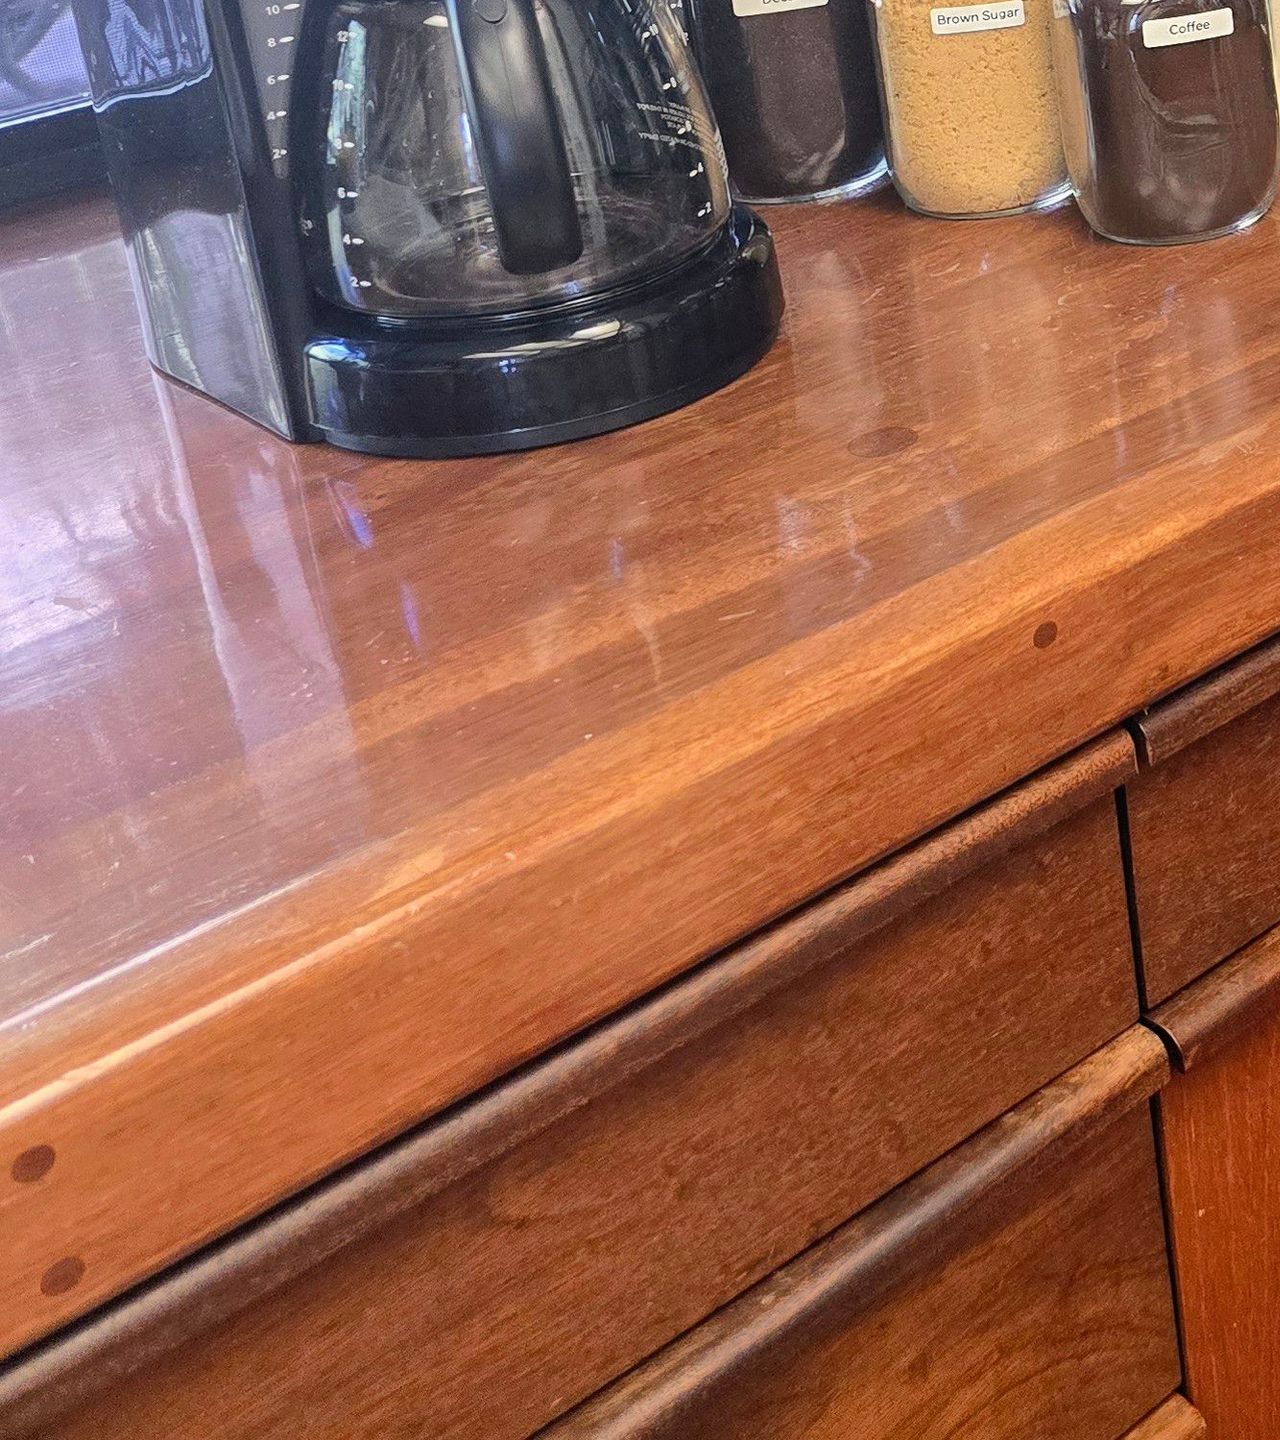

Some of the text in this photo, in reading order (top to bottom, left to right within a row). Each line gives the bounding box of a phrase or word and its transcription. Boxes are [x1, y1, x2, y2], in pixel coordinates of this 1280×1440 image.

[266, 5, 280, 15] 10
[937, 6, 1020, 27] Brown Sugar
[1168, 19, 1211, 37] Coffee
[337, 31, 348, 43] 12
[267, 37, 276, 48] 8
[267, 75, 276, 85] 6
[267, 111, 276, 121] 4
[273, 148, 281, 158] 2
[337, 187, 346, 198] 6
[343, 234, 350, 244] 4
[351, 277, 359, 287] 2
